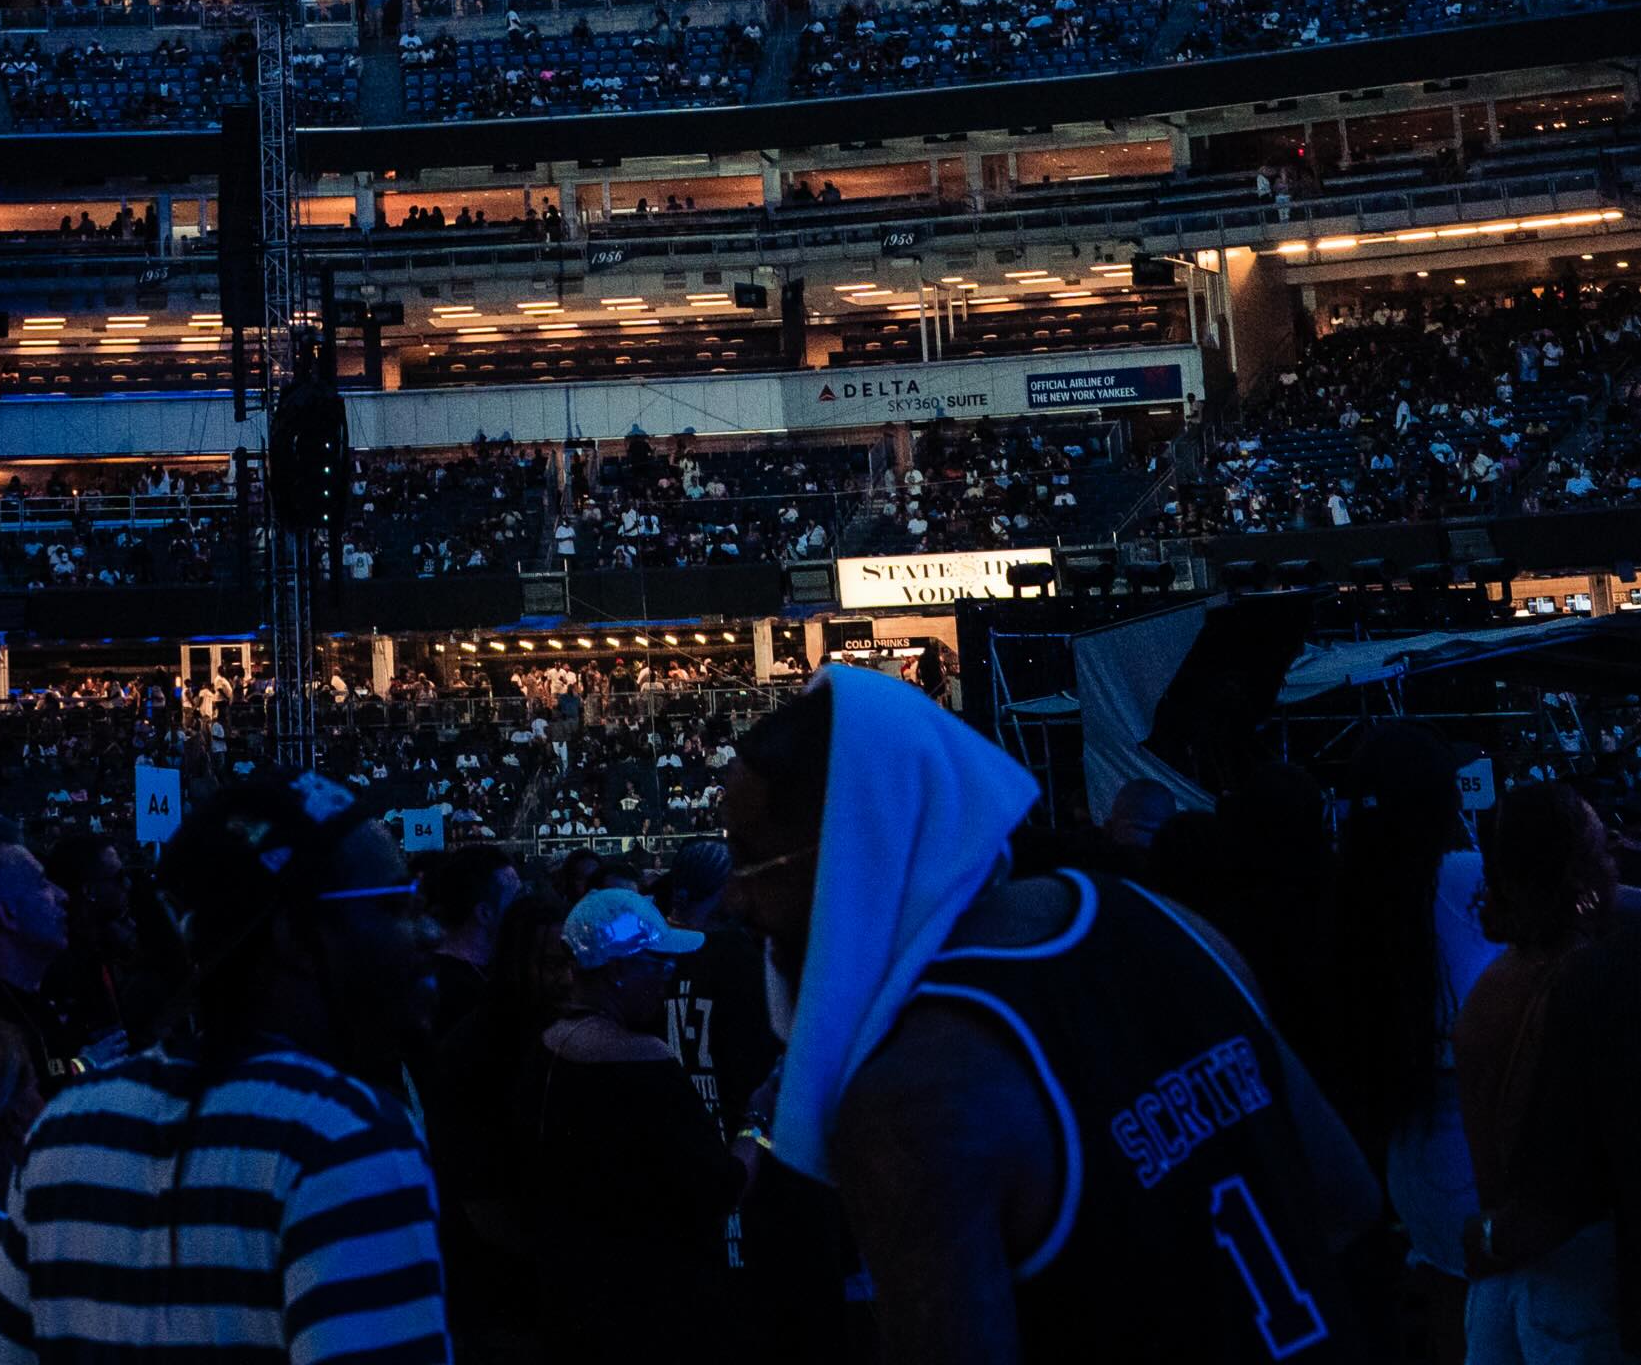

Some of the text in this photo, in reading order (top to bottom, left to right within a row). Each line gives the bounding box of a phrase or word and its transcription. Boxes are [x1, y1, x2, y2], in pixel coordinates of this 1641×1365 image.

[883, 232, 916, 247] 1958
[591, 250, 624, 265] 1956
[843, 379, 920, 398] DELTA
[1030, 375, 1116, 392] OFFICIAL AIRLINE OF
[947, 393, 988, 407] SUITE
[1031, 386, 1139, 404] THE NEW YORK YANKEES.
[862, 559, 1031, 581] STATESID
[845, 637, 910, 649] COLD DRINKS
[1461, 776, 1481, 792] B5
[148, 792, 169, 816] A4
[414, 823, 433, 837] B4
[1209, 1172, 1330, 1362] 1
